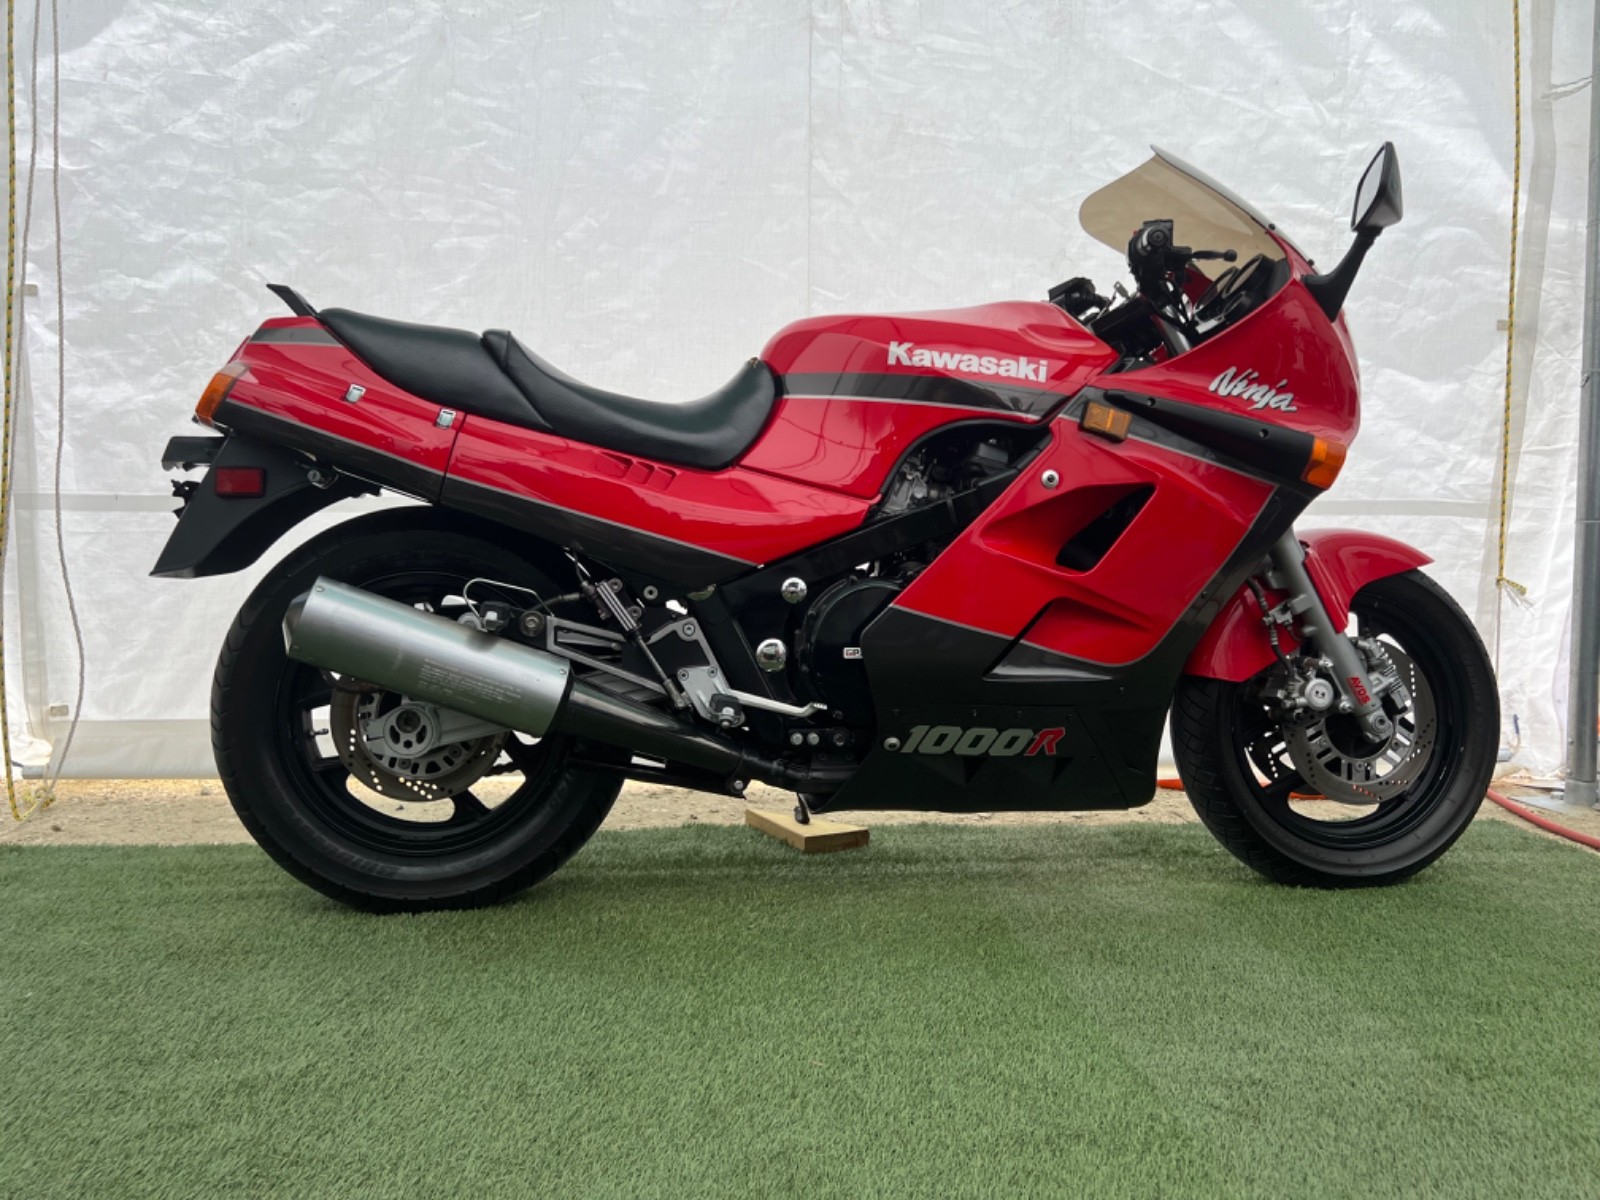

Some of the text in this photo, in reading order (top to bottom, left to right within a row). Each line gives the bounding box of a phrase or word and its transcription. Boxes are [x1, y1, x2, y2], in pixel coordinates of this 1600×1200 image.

[887, 341, 1048, 383] Kawasaki
[1208, 366, 1298, 412] Ninja
[900, 725, 1066, 756] 1000R
